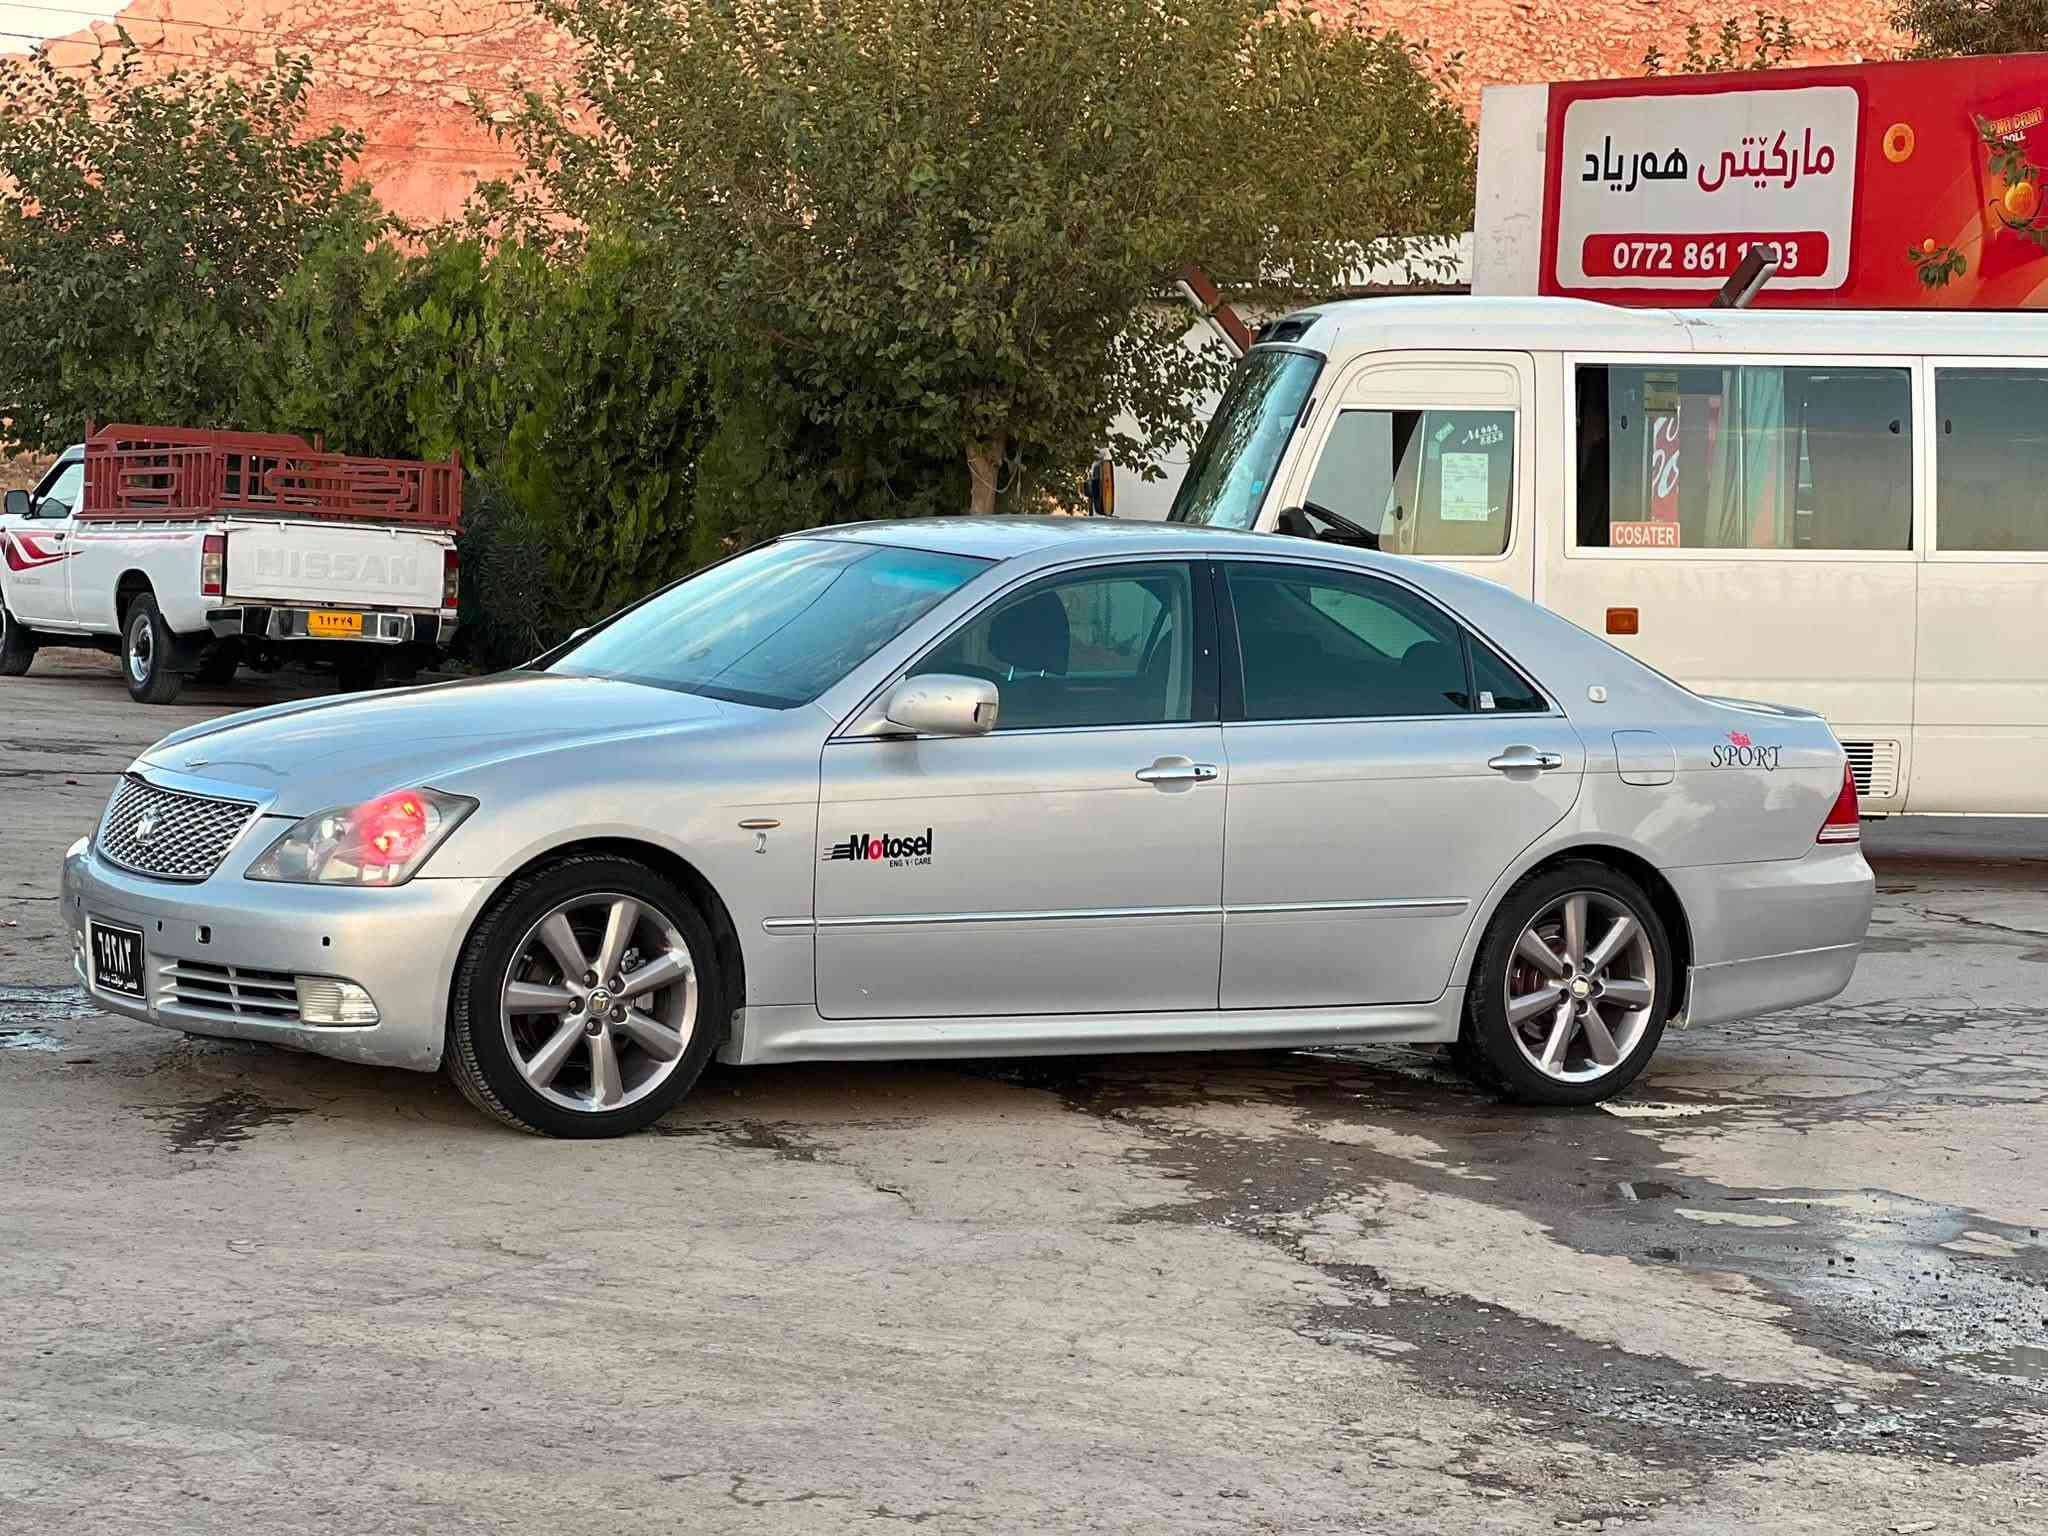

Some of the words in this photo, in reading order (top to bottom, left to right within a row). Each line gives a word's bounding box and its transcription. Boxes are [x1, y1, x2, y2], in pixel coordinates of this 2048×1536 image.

[1613, 242, 1673, 270] 0772
[1683, 242, 1727, 271] 861
[1736, 241, 1799, 270] 103
[1615, 526, 1675, 545] COSATER
[254, 548, 418, 586] NISSAN
[1710, 744, 1783, 772] SPORT
[849, 827, 933, 861] Motosel
